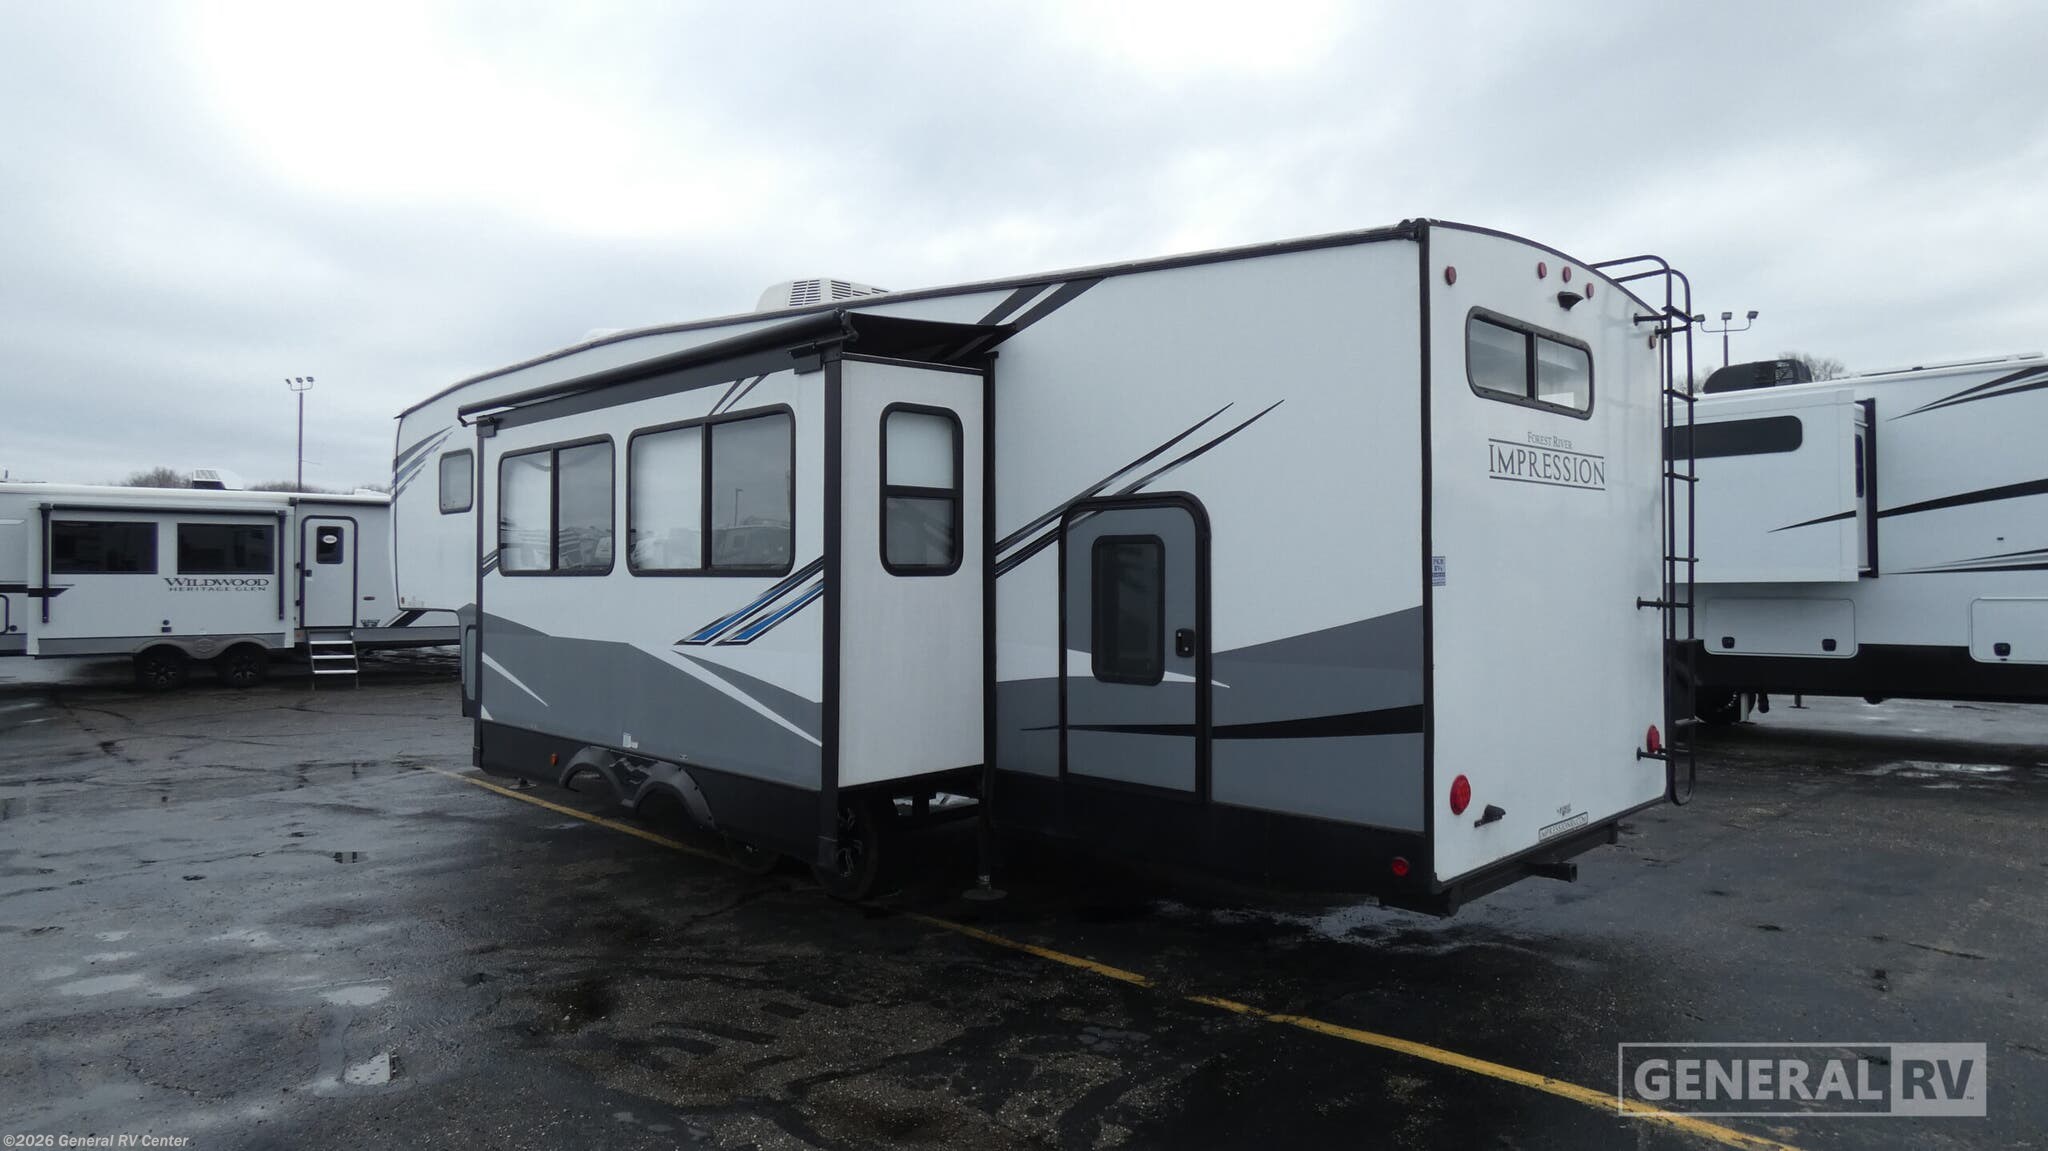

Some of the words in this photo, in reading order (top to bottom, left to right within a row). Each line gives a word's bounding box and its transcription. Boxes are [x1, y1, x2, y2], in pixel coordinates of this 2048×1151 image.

[1527, 431, 1553, 447] FOREST
[1553, 436, 1573, 449] RIVER
[1488, 444, 1605, 485] IMPRESSION
[164, 577, 270, 587] WILDWOOD
